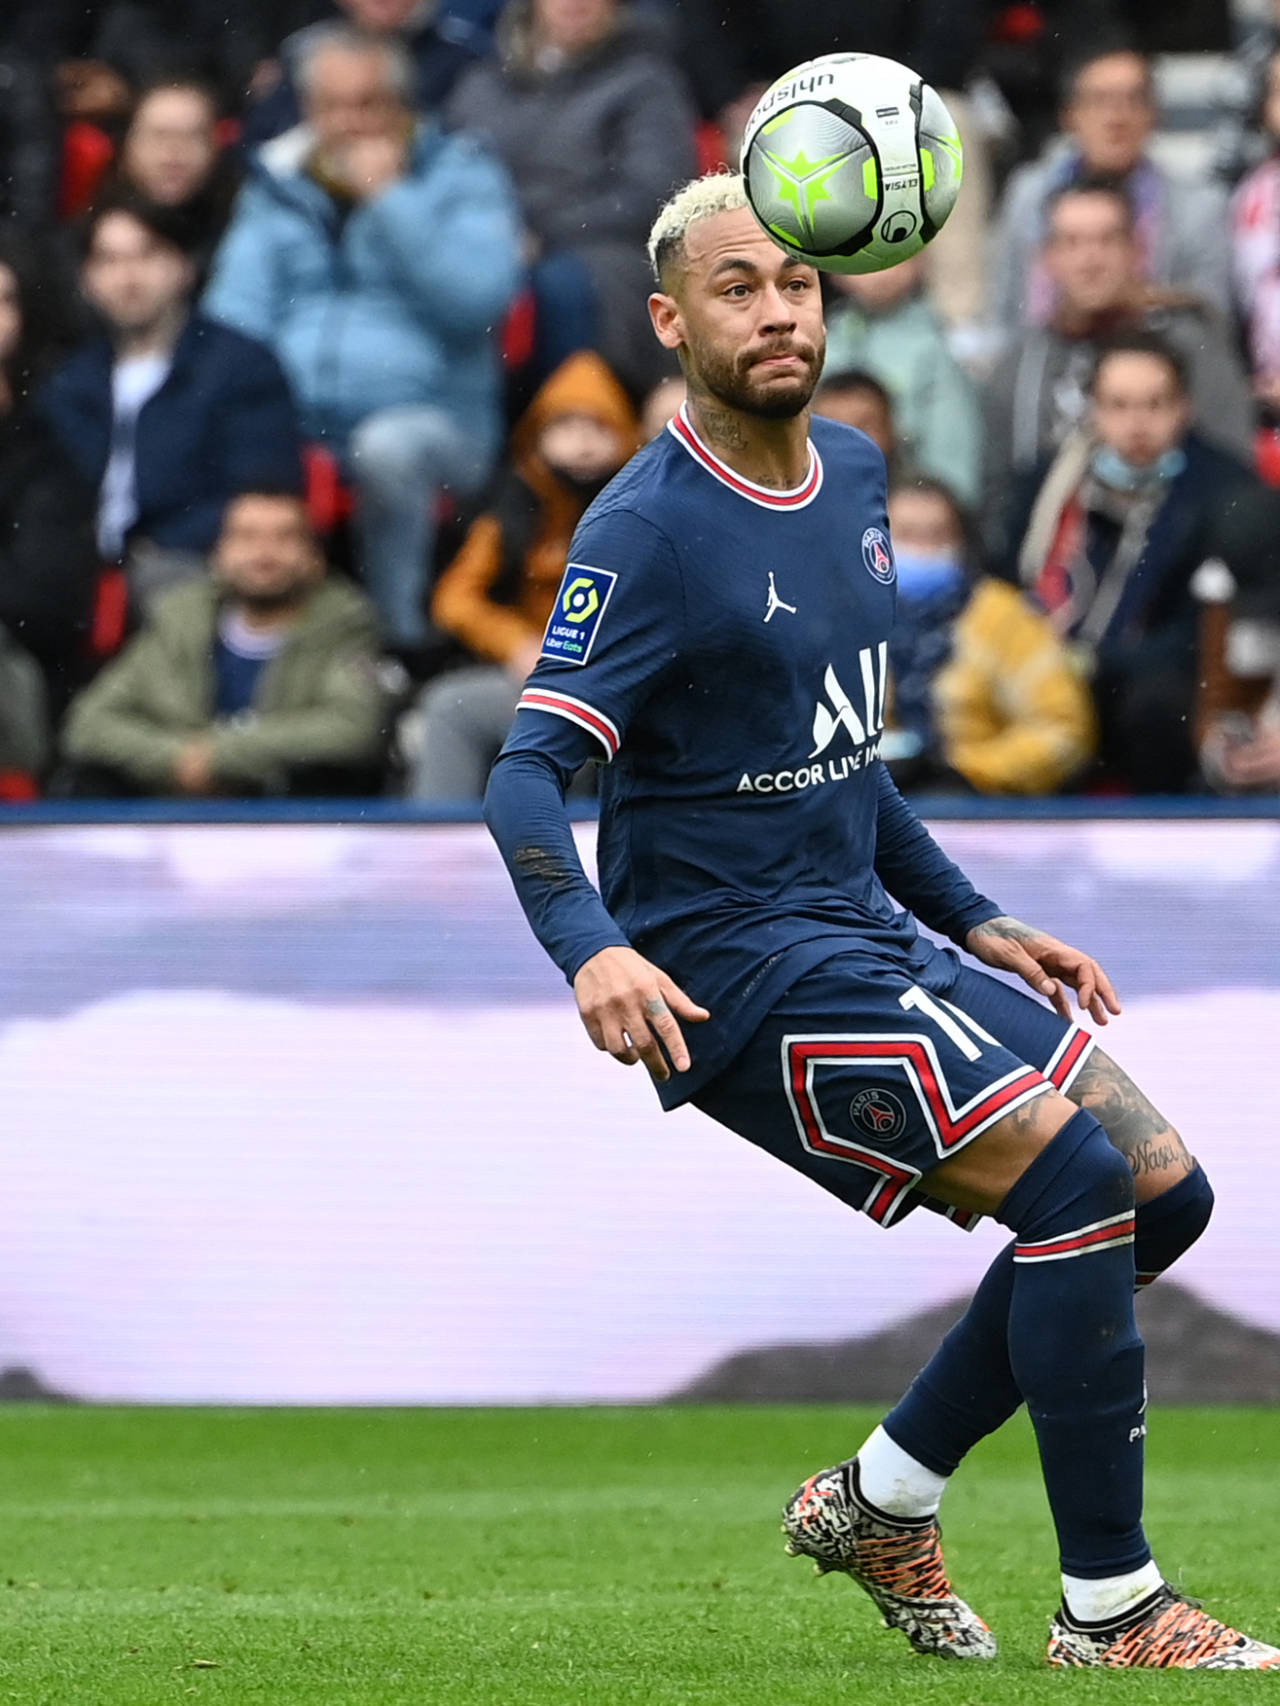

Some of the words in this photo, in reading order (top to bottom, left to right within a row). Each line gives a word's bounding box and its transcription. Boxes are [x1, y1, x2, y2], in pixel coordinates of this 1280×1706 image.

[552, 625, 578, 639] LIGUE
[546, 637, 563, 649] Uber
[562, 640, 583, 653] Eats
[736, 764, 826, 792] ACCOR
[829, 749, 863, 781] LIVE
[853, 1091, 880, 1116] PARIS
